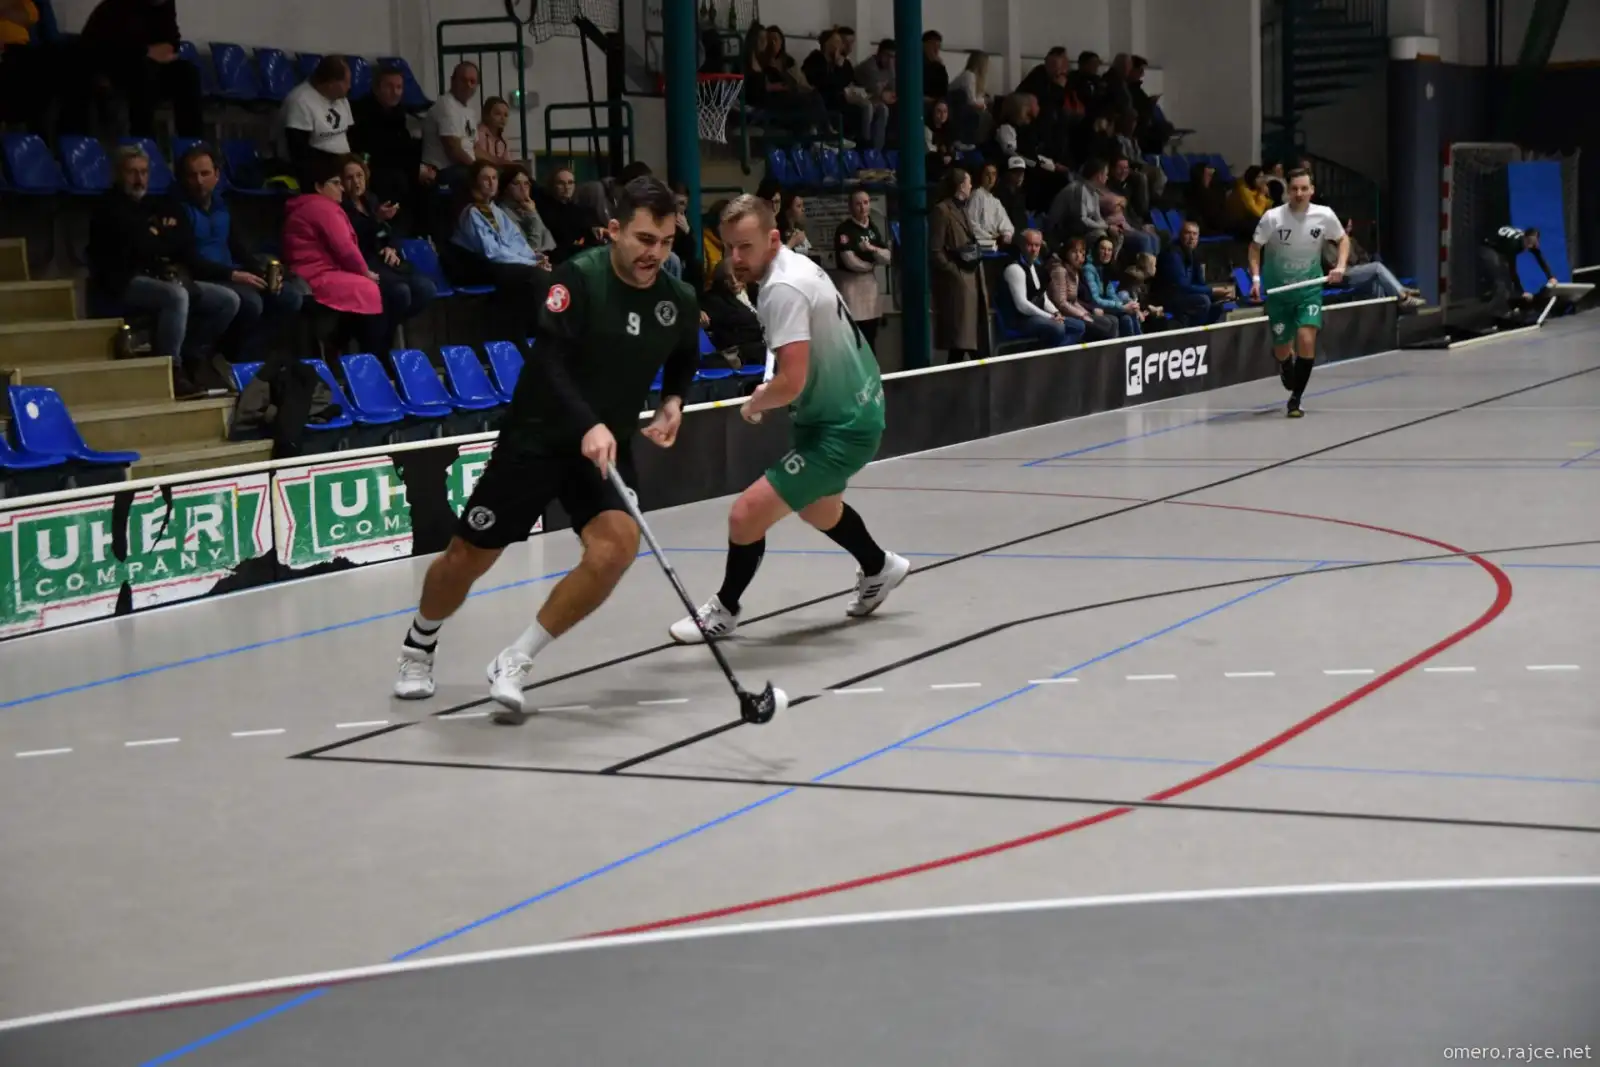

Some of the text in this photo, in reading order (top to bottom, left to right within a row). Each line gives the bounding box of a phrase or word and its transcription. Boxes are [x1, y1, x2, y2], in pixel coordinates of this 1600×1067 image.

[1278, 229, 1292, 241] 17
[1307, 304, 1319, 317] 17
[626, 312, 641, 336] 9
[780, 449, 806, 475] 16
[36, 503, 225, 571] UHER
[35, 547, 223, 597] COMPANY
